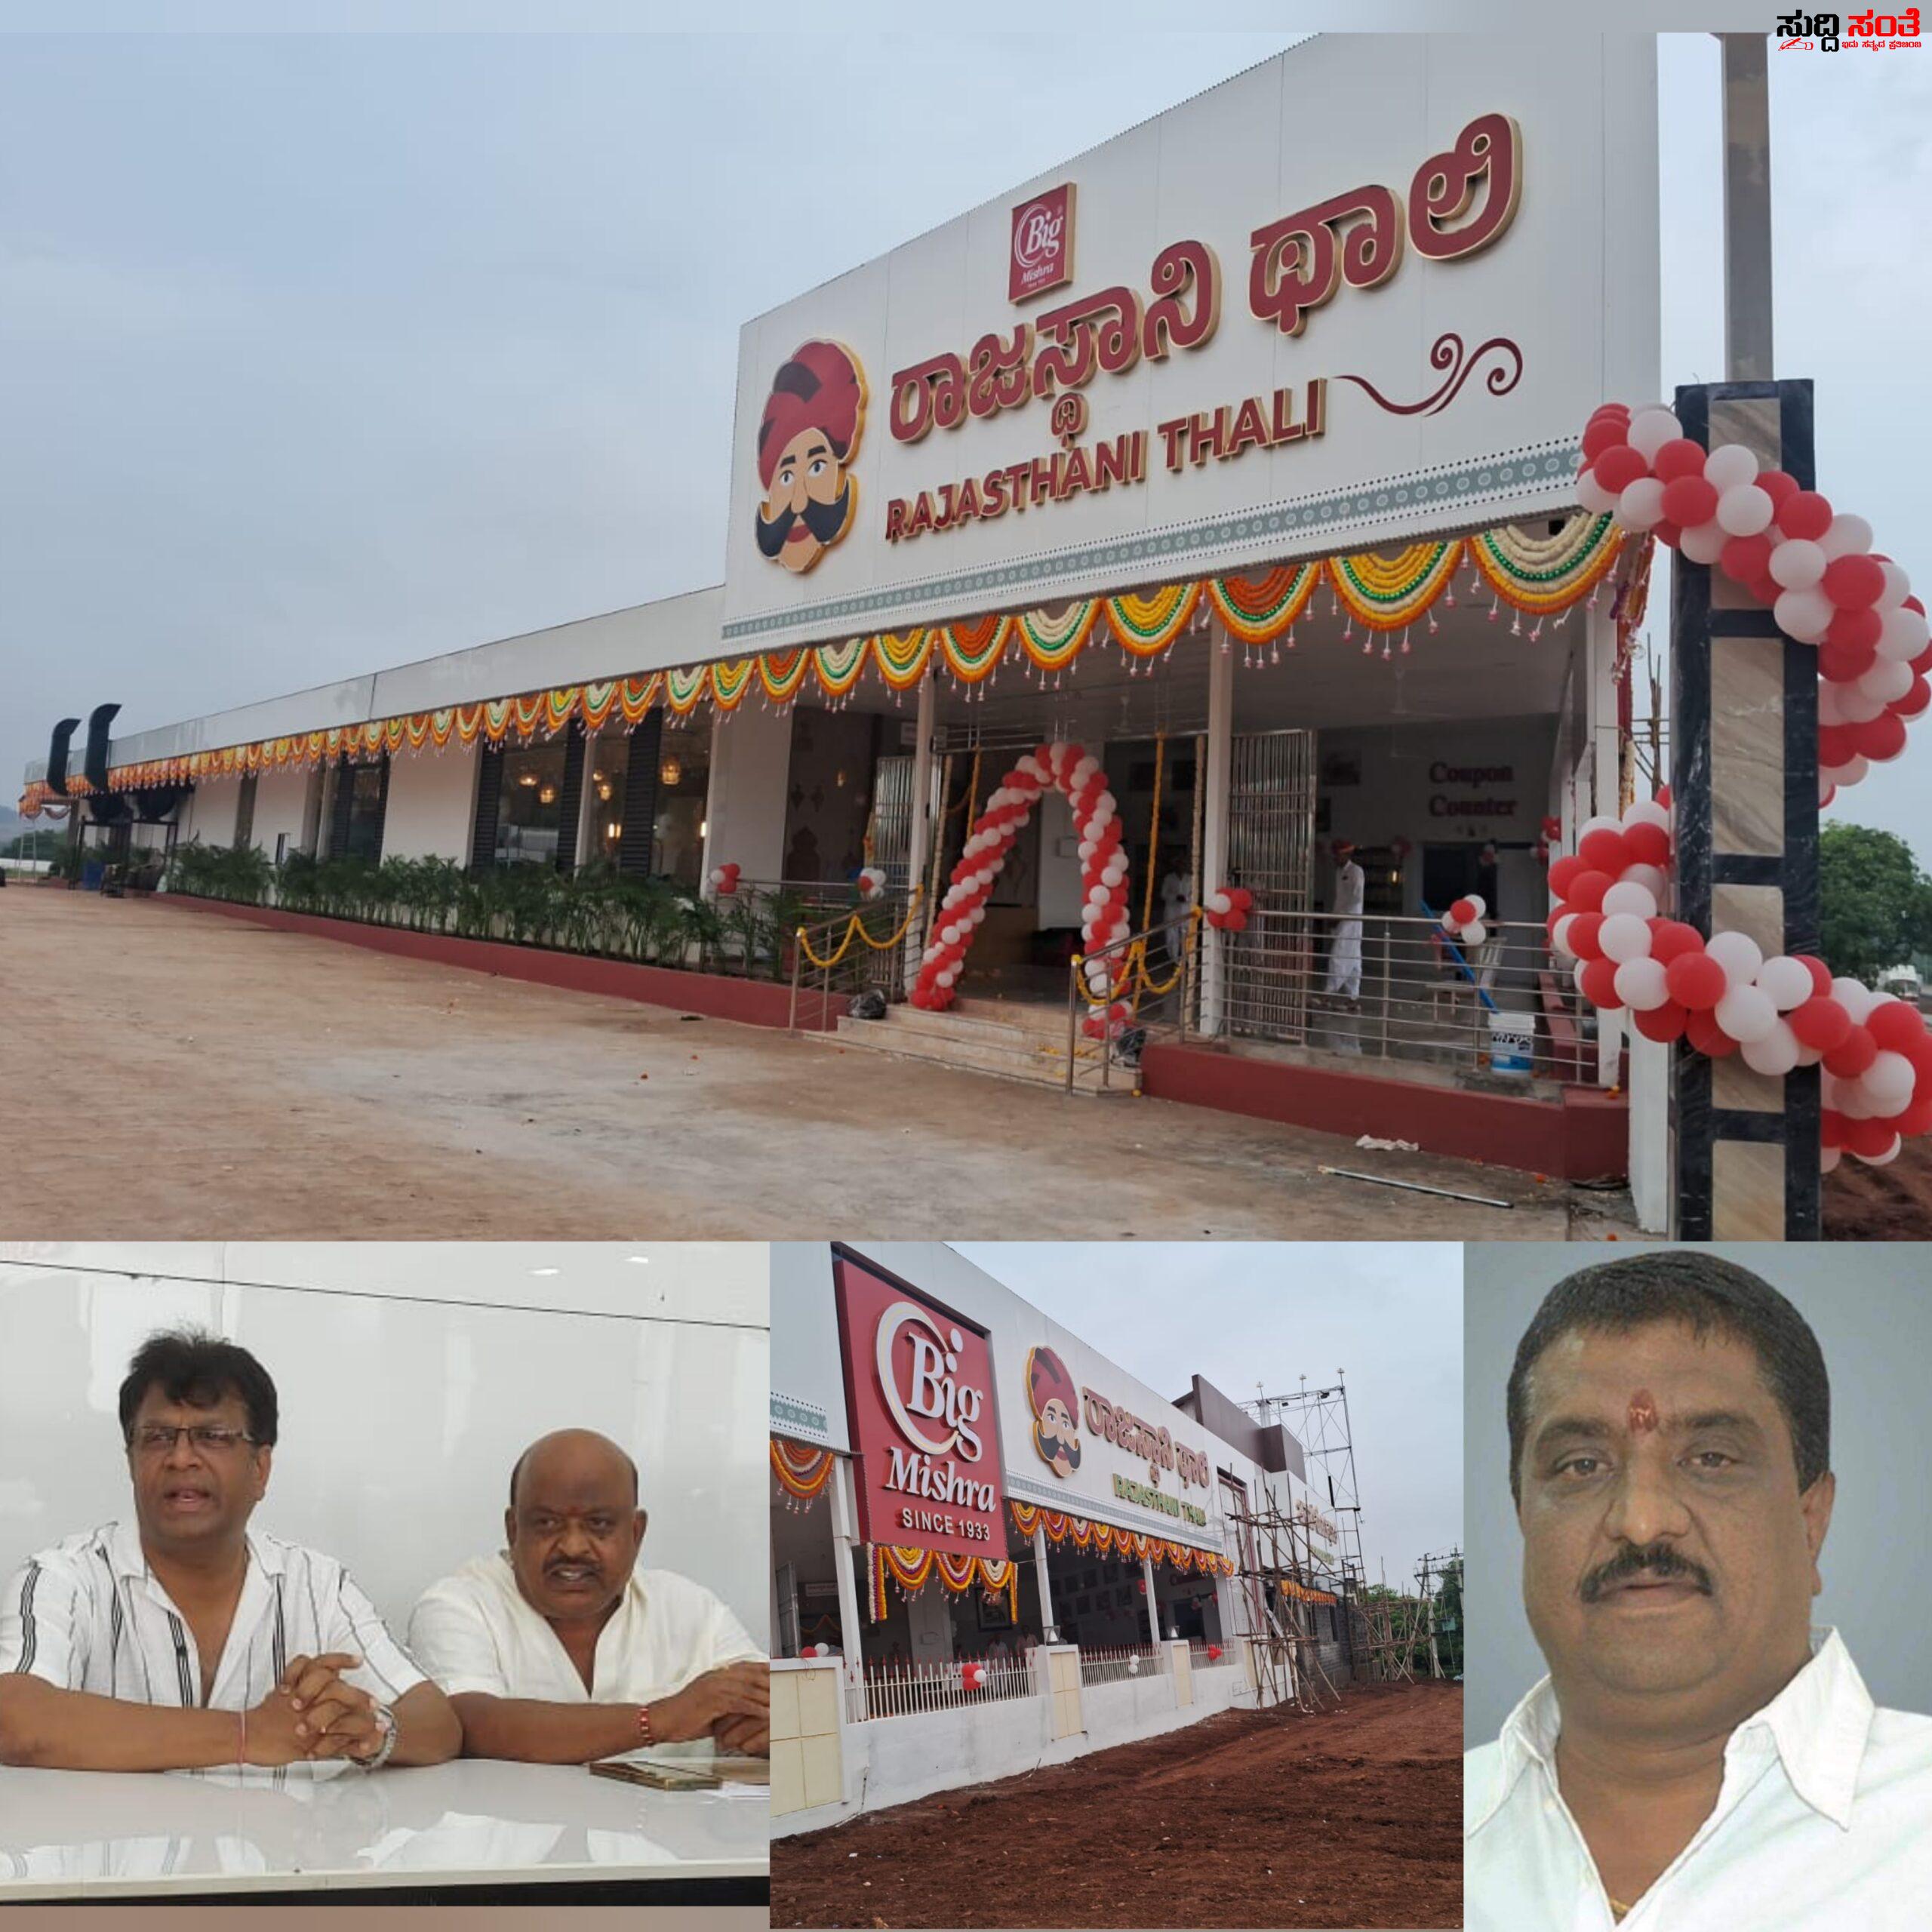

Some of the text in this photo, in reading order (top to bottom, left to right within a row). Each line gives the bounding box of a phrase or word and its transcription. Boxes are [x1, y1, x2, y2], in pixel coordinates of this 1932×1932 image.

[1025, 211, 1063, 258] Big
[890, 112, 1523, 451] ರಾಜಸ್ಥಾನಿ ಥಾಲಿ
[1021, 263, 1054, 285] Mishra
[885, 377, 1328, 543] RAJASTHANI THALI
[906, 1327, 983, 1463] Big
[884, 1444, 996, 1513] Mishra
[901, 1507, 991, 1541] SINCE 1933
